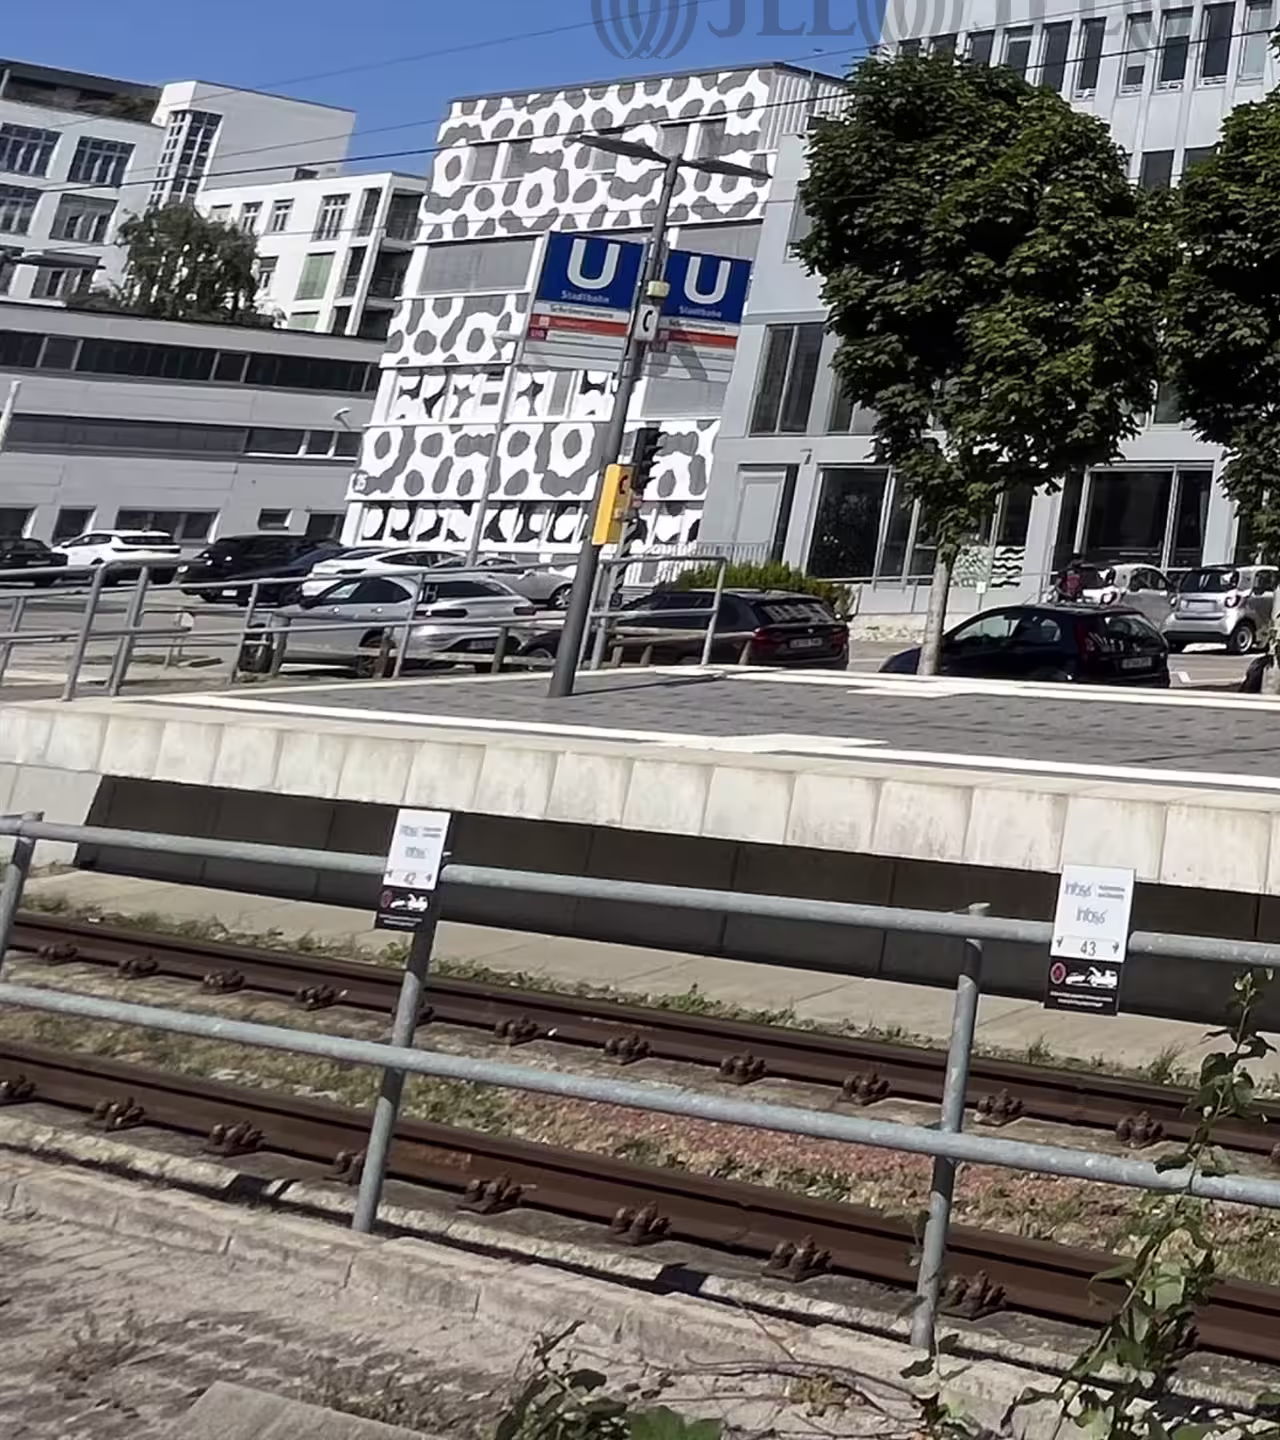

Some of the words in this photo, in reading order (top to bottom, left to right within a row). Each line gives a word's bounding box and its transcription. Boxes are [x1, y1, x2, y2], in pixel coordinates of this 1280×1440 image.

[567, 238, 621, 289] U
[684, 256, 731, 304] U
[560, 290, 610, 303] Stadtbahn
[1080, 940, 1097, 957] 43
